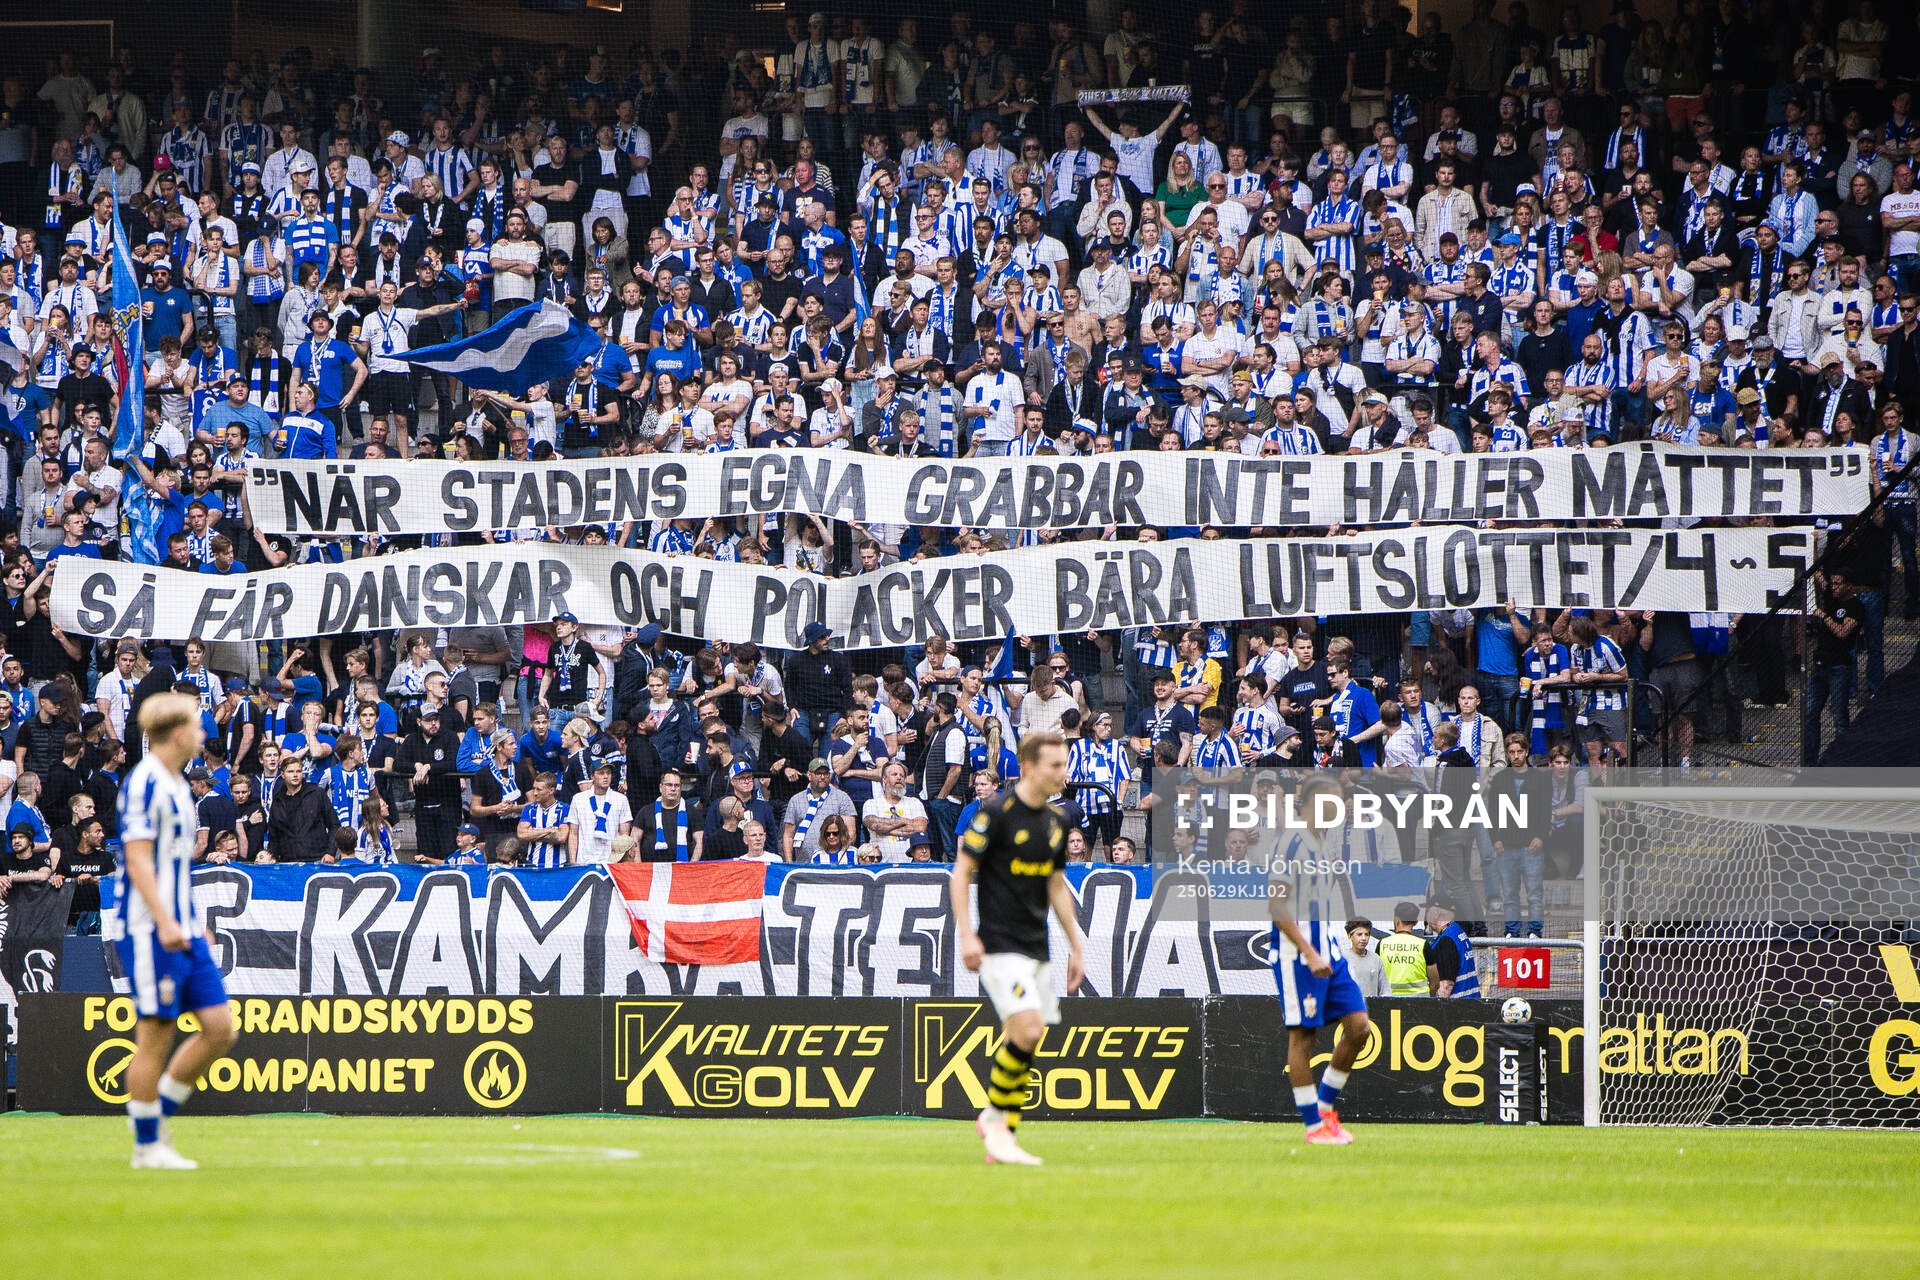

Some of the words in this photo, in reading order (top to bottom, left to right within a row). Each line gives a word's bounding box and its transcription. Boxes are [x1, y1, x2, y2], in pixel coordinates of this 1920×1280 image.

[442, 463, 688, 530] STADENS
[719, 454, 866, 520] EGNA
[905, 459, 1145, 528] GRABBAR
[1185, 457, 1310, 525] INTE
[1343, 451, 1545, 523] HÅLLER
[77, 572, 156, 638] SÅ
[188, 578, 294, 641] FÅR
[317, 560, 573, 634] DANSKAR
[611, 560, 713, 640] OCH
[750, 563, 1015, 649] POLACKER
[1055, 547, 1200, 632] BÄRA
[1382, 943, 1420, 952] PUBLIK
[1503, 957, 1543, 979] 101
[195, 1056, 435, 1094] OMPANIET
[693, 1065, 875, 1108] GOLV
[1499, 1046, 1520, 1122] SELECT
[1539, 1046, 1549, 1122] SELECT
